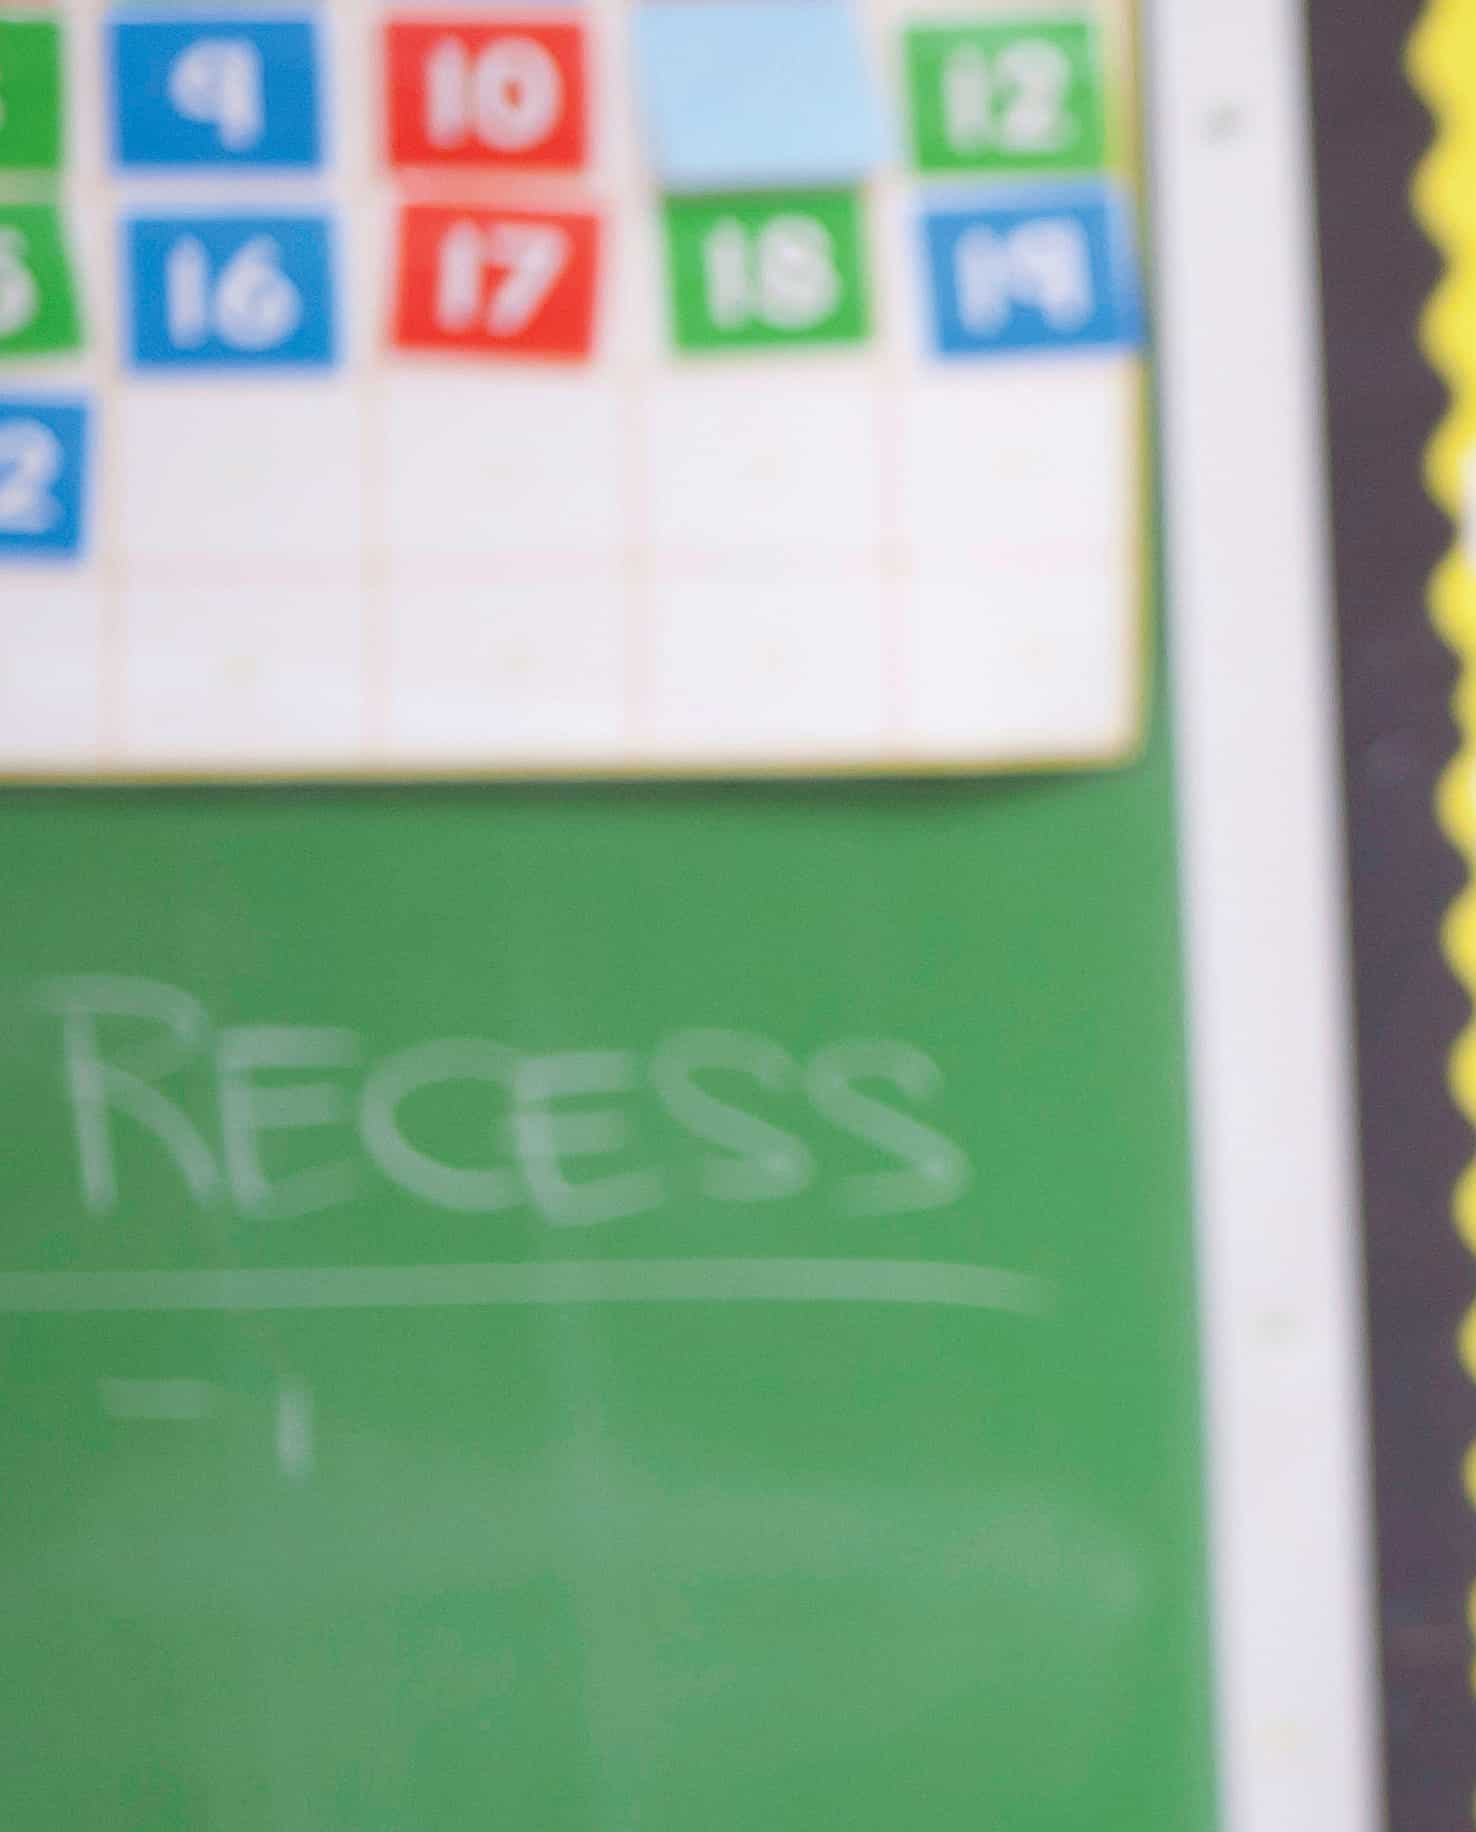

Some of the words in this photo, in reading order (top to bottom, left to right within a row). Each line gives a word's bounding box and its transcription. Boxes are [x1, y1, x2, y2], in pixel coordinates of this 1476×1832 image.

[168, 38, 266, 152] 9
[421, 35, 563, 153] 10
[941, 38, 1076, 156] 12
[163, 232, 302, 350] 16
[432, 217, 574, 336] 17
[702, 213, 840, 330] 18
[953, 217, 1096, 338] 19
[0, 420, 62, 535] 2
[36, 972, 972, 1229] RECESS
